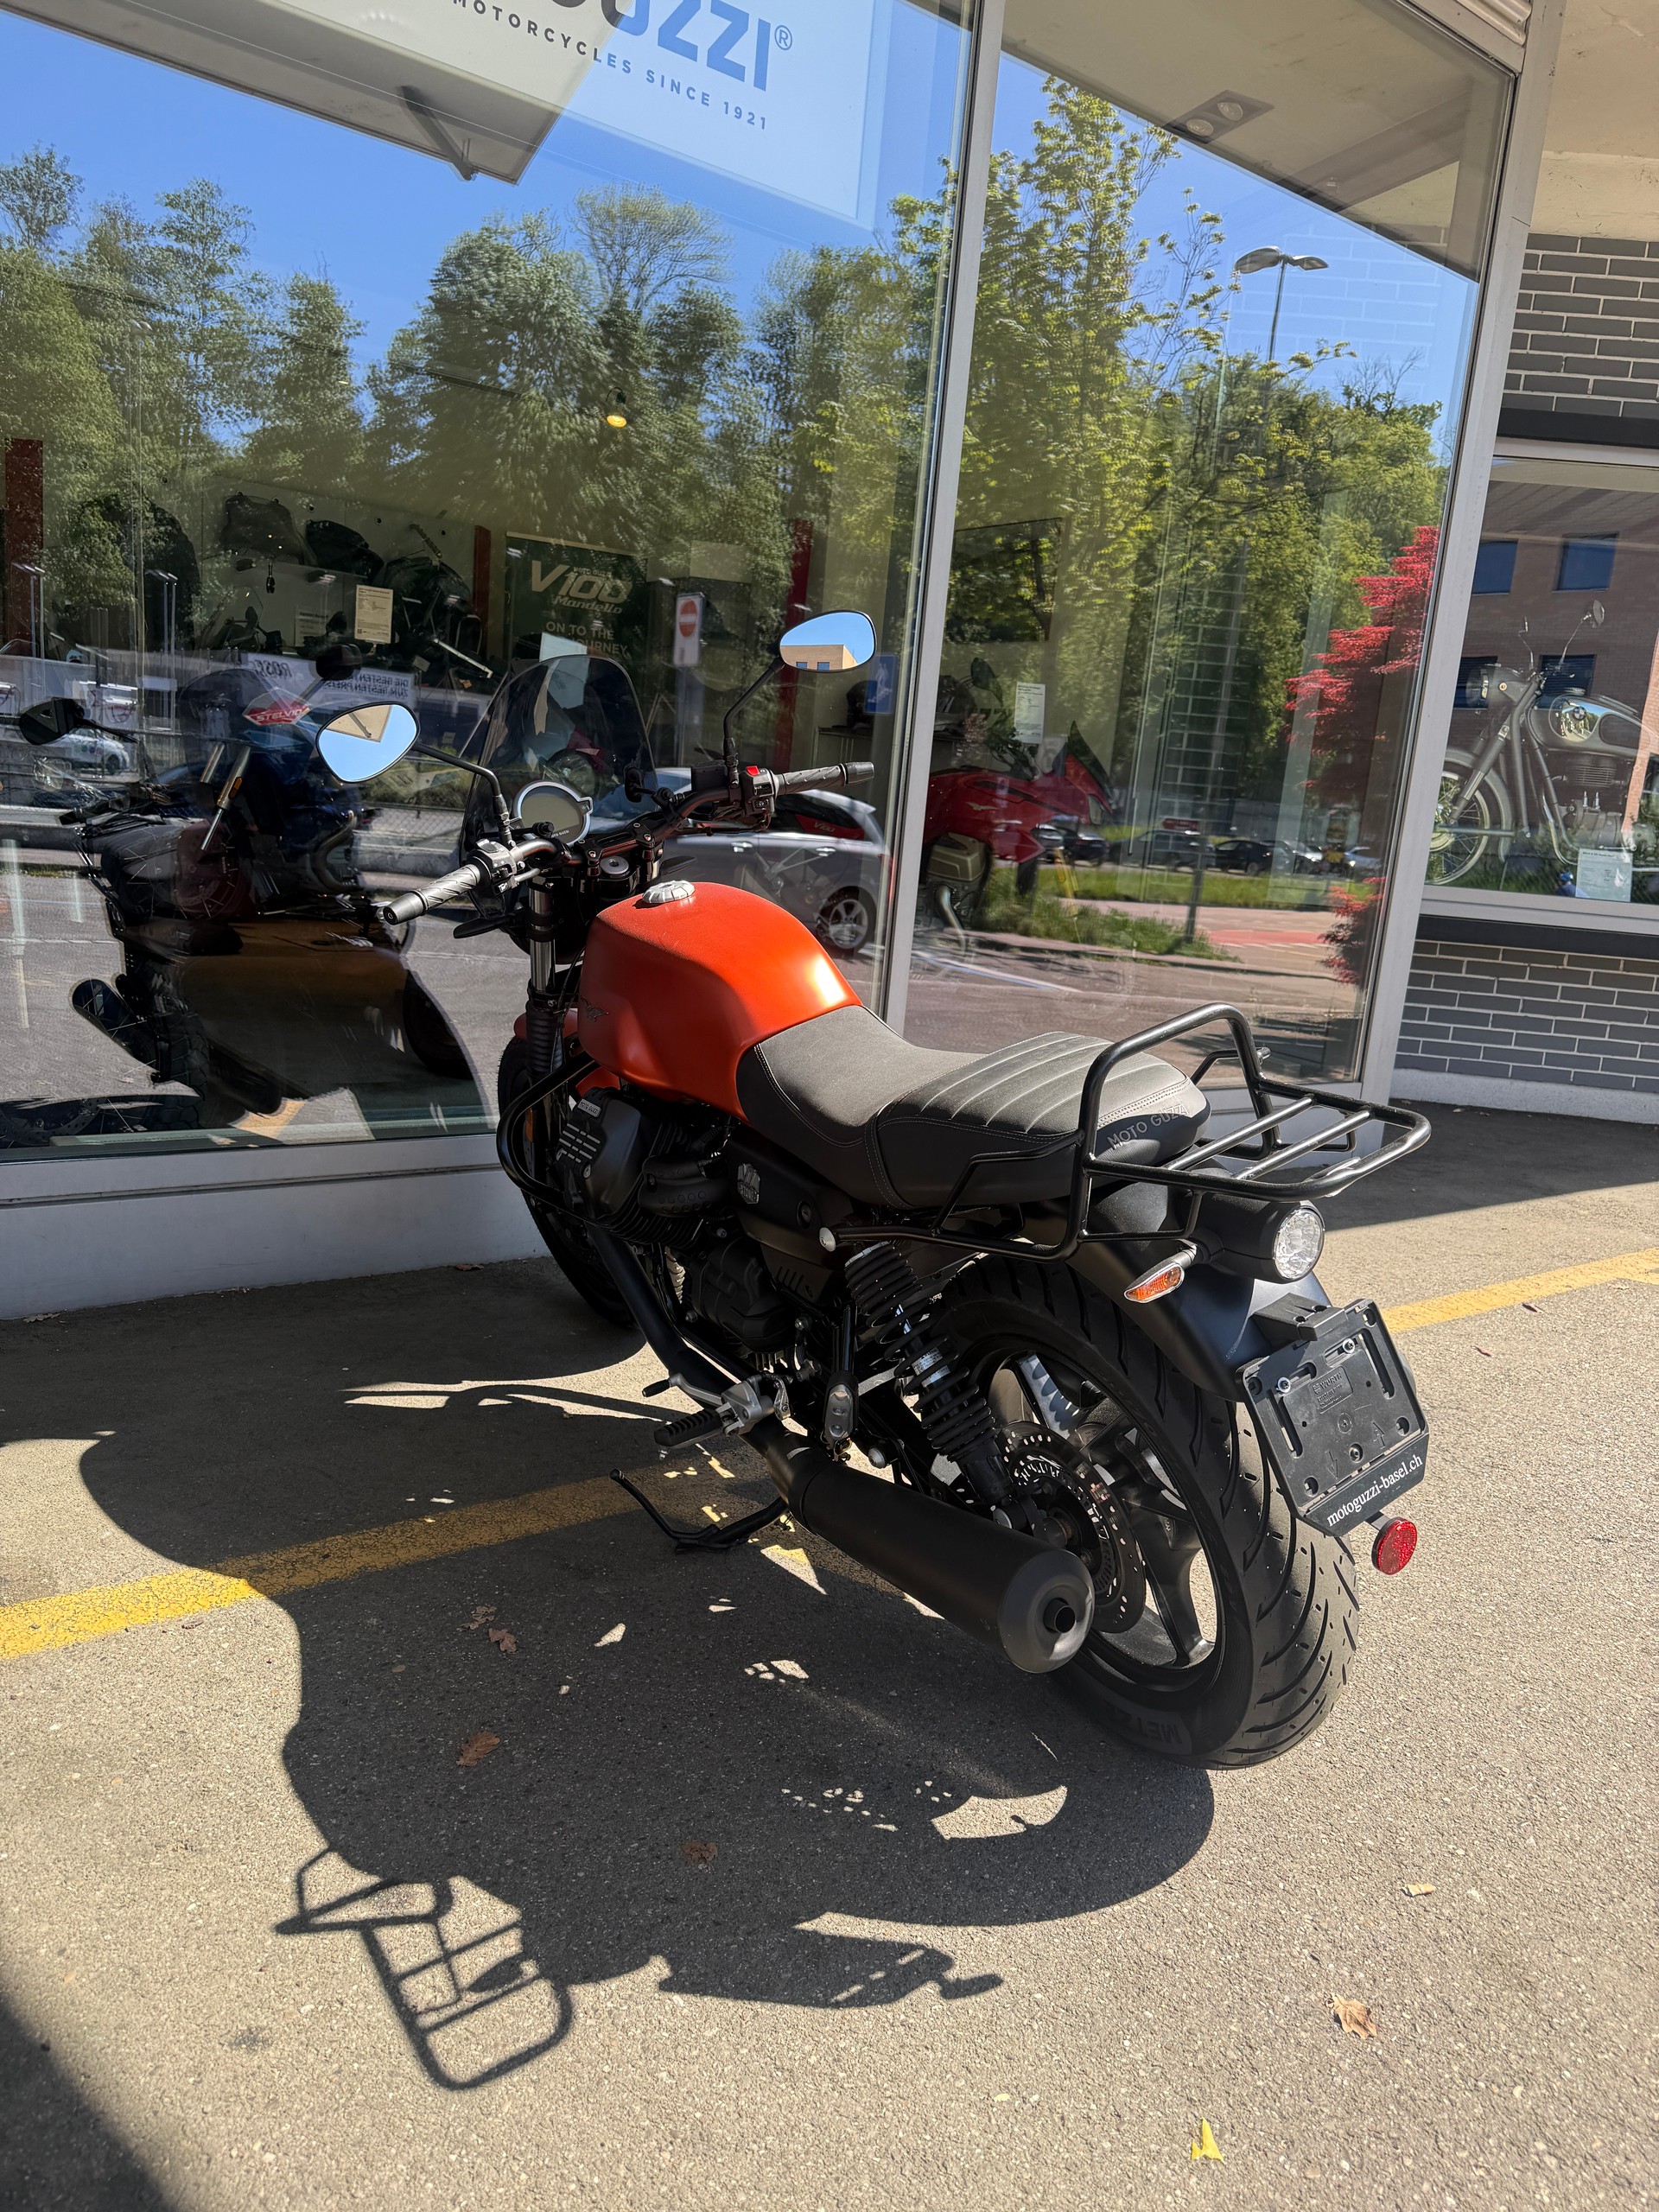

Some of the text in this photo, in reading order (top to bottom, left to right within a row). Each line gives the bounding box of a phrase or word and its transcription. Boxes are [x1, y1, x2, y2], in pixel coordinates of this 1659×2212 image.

[645, 69, 711, 106] SINCE
[723, 101, 767, 130] 1921
[531, 560, 633, 604] V100
[553, 596, 623, 614] Mandello
[546, 621, 614, 641] ON TO THE
[257, 709, 303, 721] STELVIO
[1107, 1103, 1190, 1150] MOTO GUZZI
[1326, 1453, 1424, 1527] motoguzzi-basel.ch
